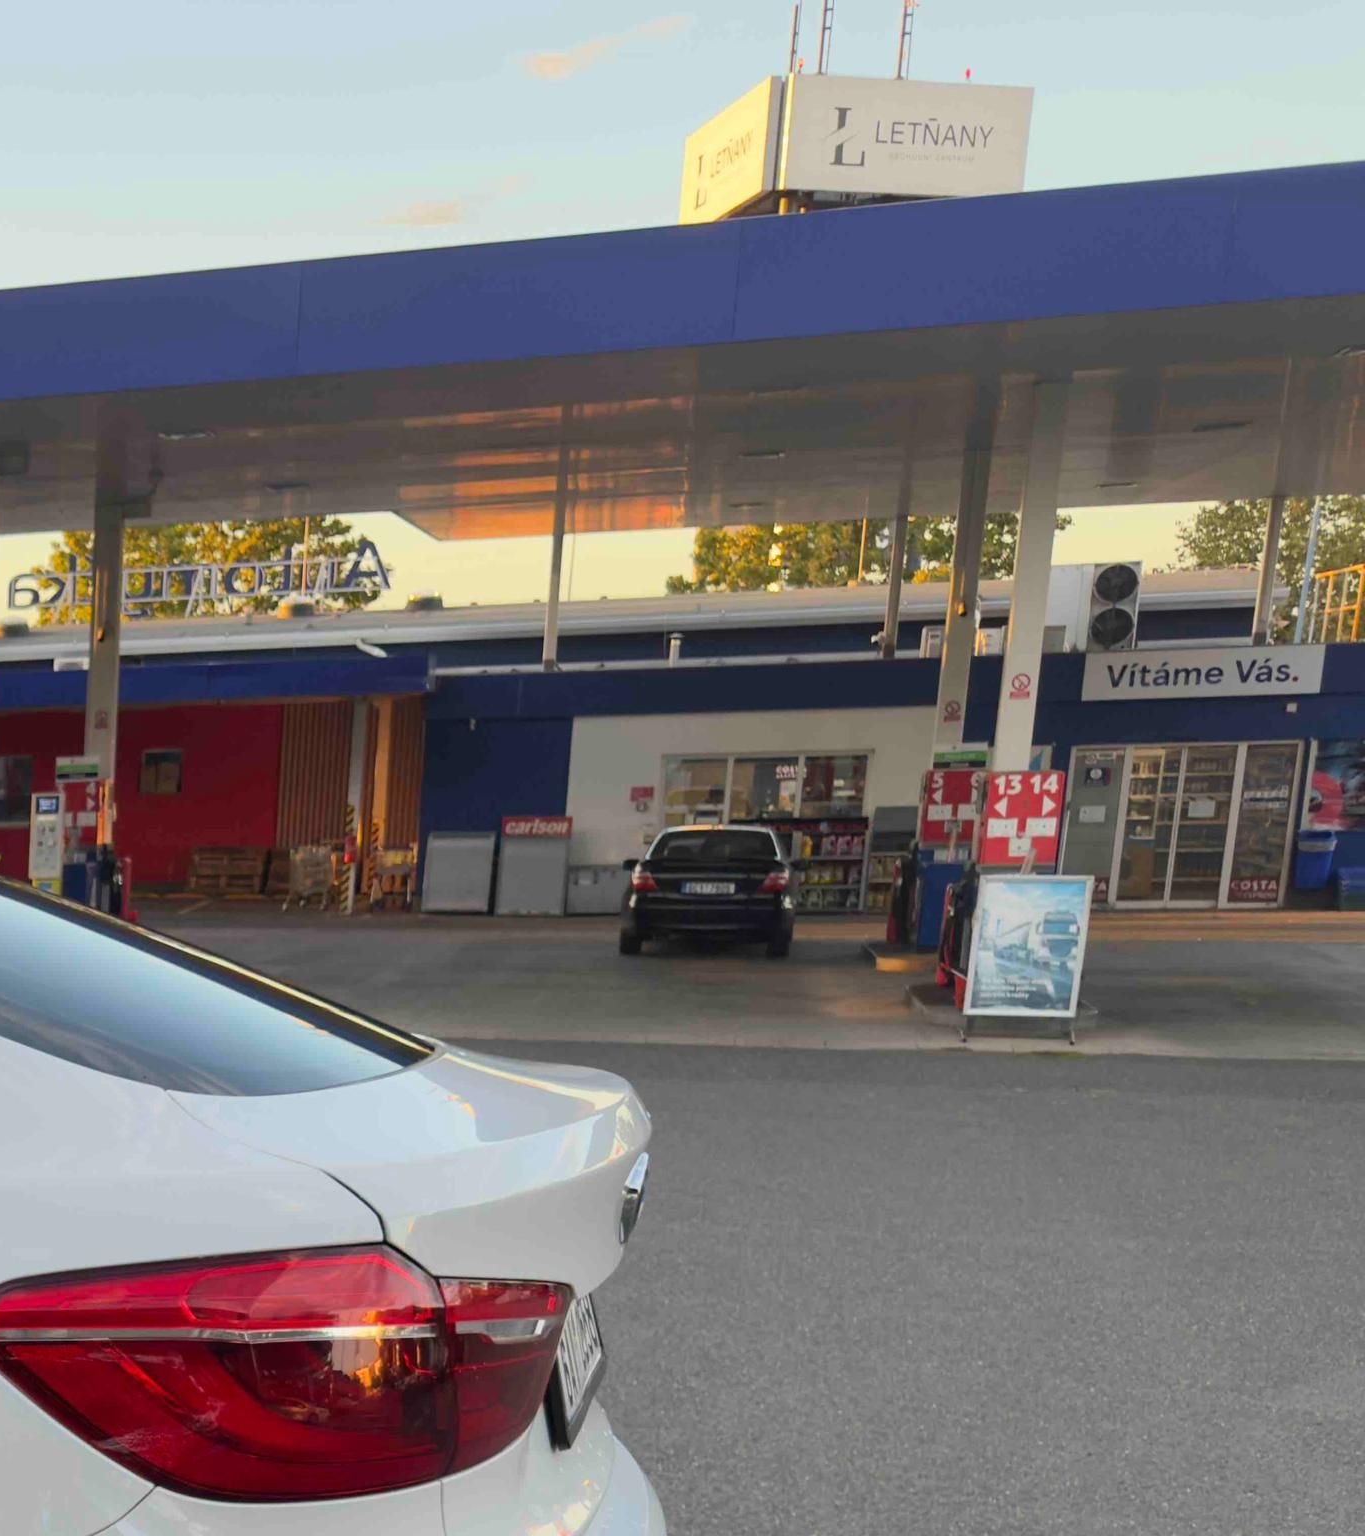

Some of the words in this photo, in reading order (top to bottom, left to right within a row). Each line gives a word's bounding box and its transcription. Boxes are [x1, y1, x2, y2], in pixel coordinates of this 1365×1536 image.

[1107, 660, 1224, 689] Vítáme
[1235, 657, 1299, 684] Vás.
[932, 772, 944, 788] 5
[994, 774, 1022, 795] 13
[1030, 773, 1059, 795] 14
[505, 818, 569, 835] carlson
[1230, 879, 1278, 891] COSTA
